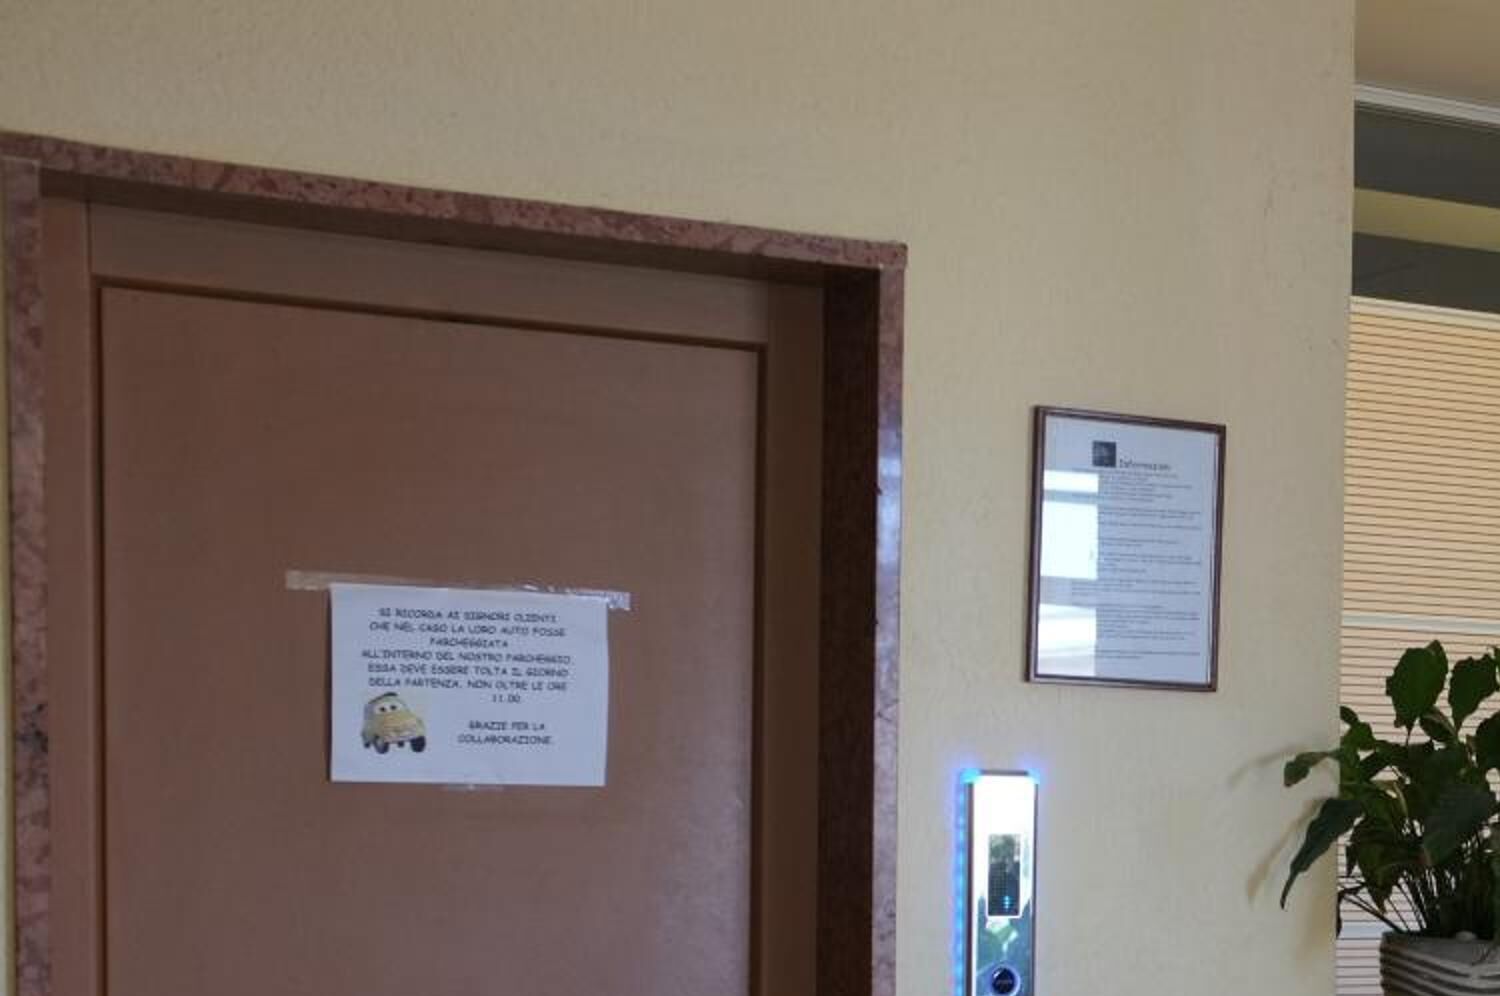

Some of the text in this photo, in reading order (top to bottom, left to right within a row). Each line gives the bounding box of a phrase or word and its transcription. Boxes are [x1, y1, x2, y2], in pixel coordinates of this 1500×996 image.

[395, 608, 442, 619] RICORDA
[464, 611, 510, 621] SIGNORI
[513, 613, 557, 623] CLIENTI
[369, 621, 567, 637] CHE NEL CASO LA LORO AUTO FOSSE
[429, 637, 508, 649] PARCHEGGIATA
[361, 649, 433, 661] ALL'INTERNO
[436, 651, 456, 662] DEL
[459, 652, 503, 663] NOSTRO
[368, 663, 570, 677] ESSA DEVE ESSERE TOLTA IL GIORNO
[368, 677, 401, 687] DELLA
[467, 679, 492, 690] NON
[495, 680, 528, 691] OLTRE
[531, 681, 544, 691] LE
[547, 681, 568, 692] ORE
[468, 720, 546, 731] GRAZIE PER LA
